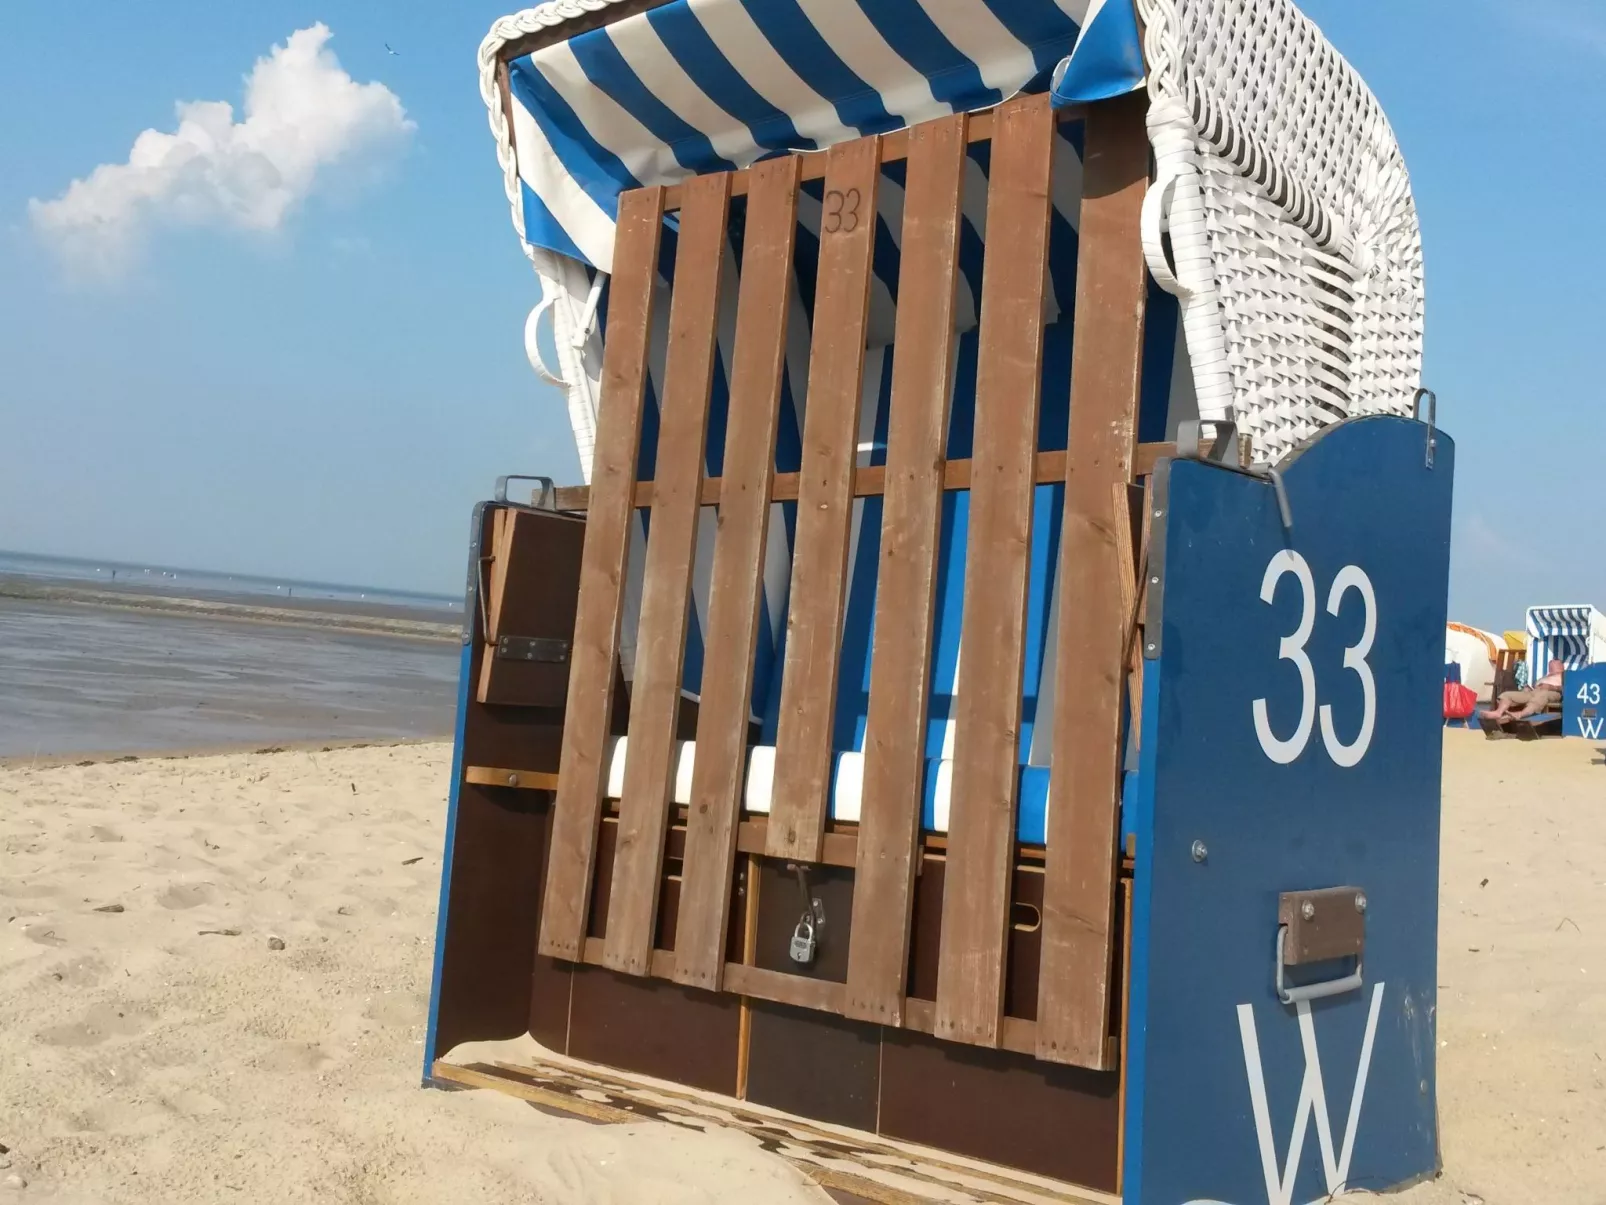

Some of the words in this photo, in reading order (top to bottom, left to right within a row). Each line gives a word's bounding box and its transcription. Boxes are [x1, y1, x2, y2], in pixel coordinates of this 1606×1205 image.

[825, 188, 861, 233] 33
[1252, 549, 1377, 768] 33
[1577, 683, 1601, 705] 43
[1577, 717, 1604, 738] W
[1236, 982, 1385, 1205] W
